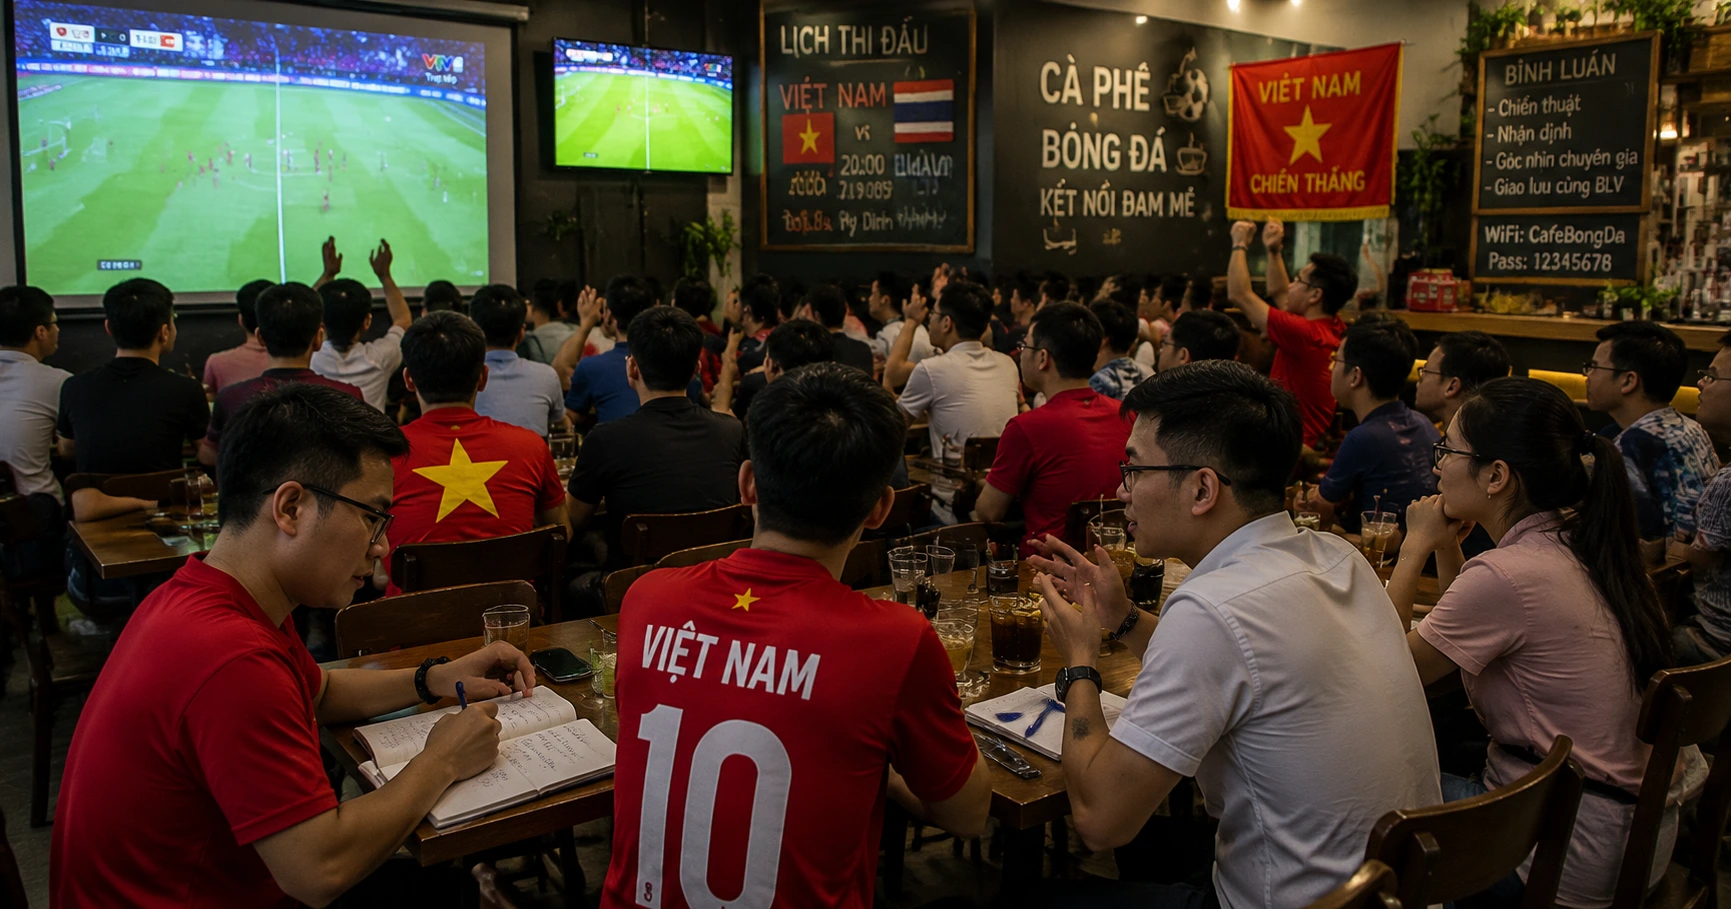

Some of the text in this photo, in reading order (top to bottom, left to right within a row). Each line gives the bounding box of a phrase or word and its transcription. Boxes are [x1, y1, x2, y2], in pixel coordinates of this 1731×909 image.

[838, 25, 873, 55] THI
[838, 82, 886, 108] NAM
[1040, 53, 1151, 112] CÀ PHÊ
[1312, 70, 1361, 100] NAM
[1128, 126, 1167, 172] ĐÁ
[1616, 148, 1638, 170] gia
[1494, 178, 1525, 196] Giao
[1595, 176, 1625, 193] BLV
[1122, 189, 1164, 217] ĐAM
[1485, 224, 1626, 248] WiFi: CafeBongDa
[1488, 251, 1612, 272] Pass: 12345678
[641, 620, 821, 701] VIỆT NAM
[635, 703, 792, 909] 10
